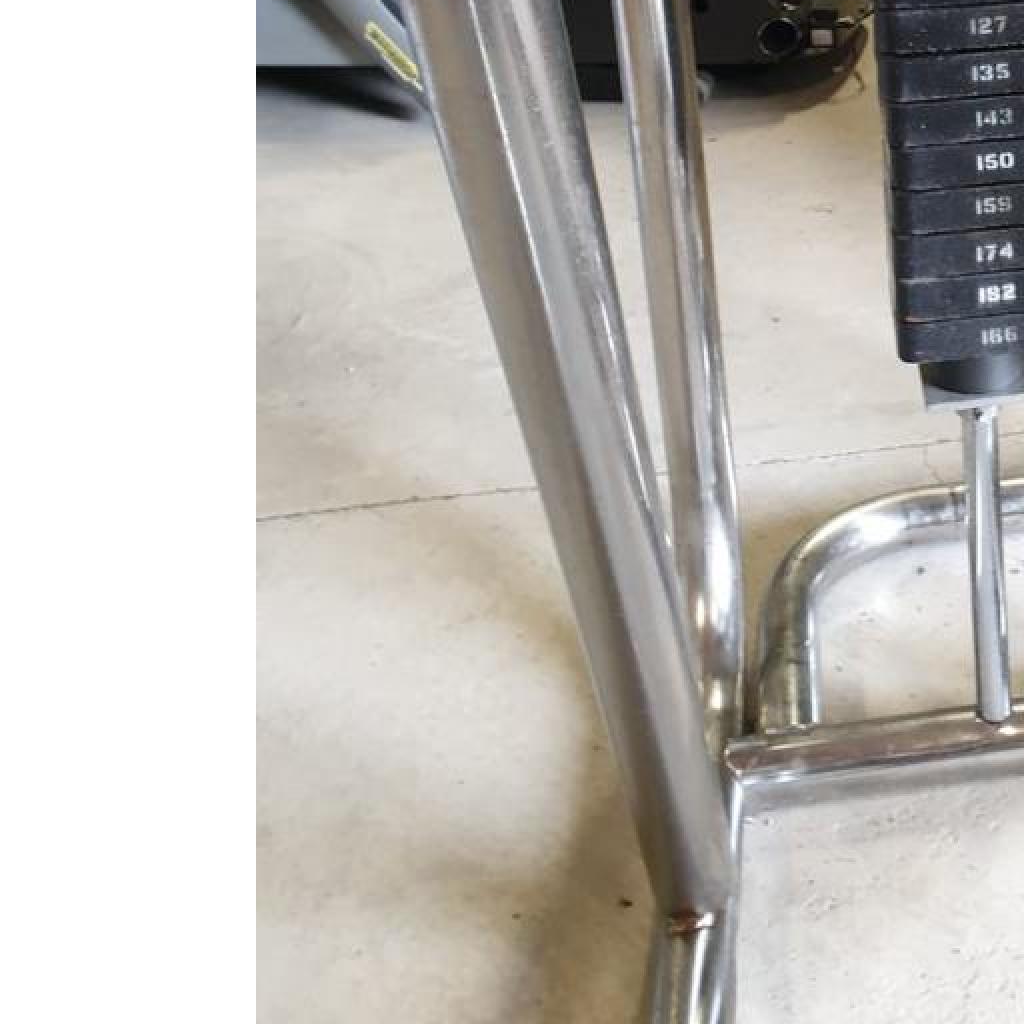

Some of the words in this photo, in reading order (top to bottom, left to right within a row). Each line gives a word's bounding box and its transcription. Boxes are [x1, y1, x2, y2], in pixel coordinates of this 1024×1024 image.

[969, 15, 1007, 35] 127
[972, 63, 1010, 81] 135
[976, 108, 1013, 127] 143
[976, 152, 1014, 171] 150
[976, 242, 1013, 262] 174
